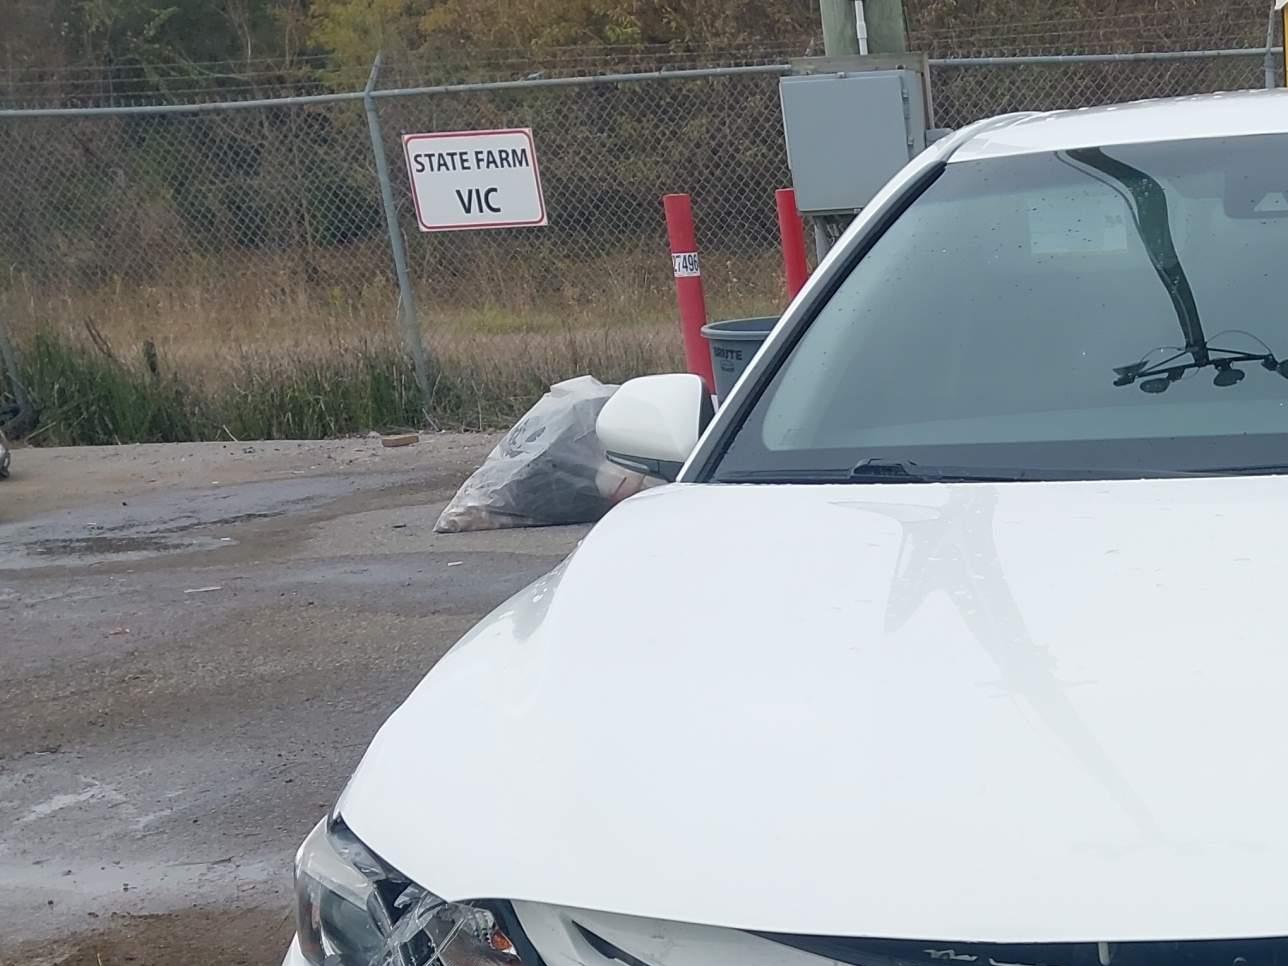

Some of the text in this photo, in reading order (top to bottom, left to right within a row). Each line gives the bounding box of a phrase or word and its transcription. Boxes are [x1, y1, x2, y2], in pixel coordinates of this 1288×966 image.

[413, 148, 530, 173] STATE FARM
[455, 187, 502, 214] VIC
